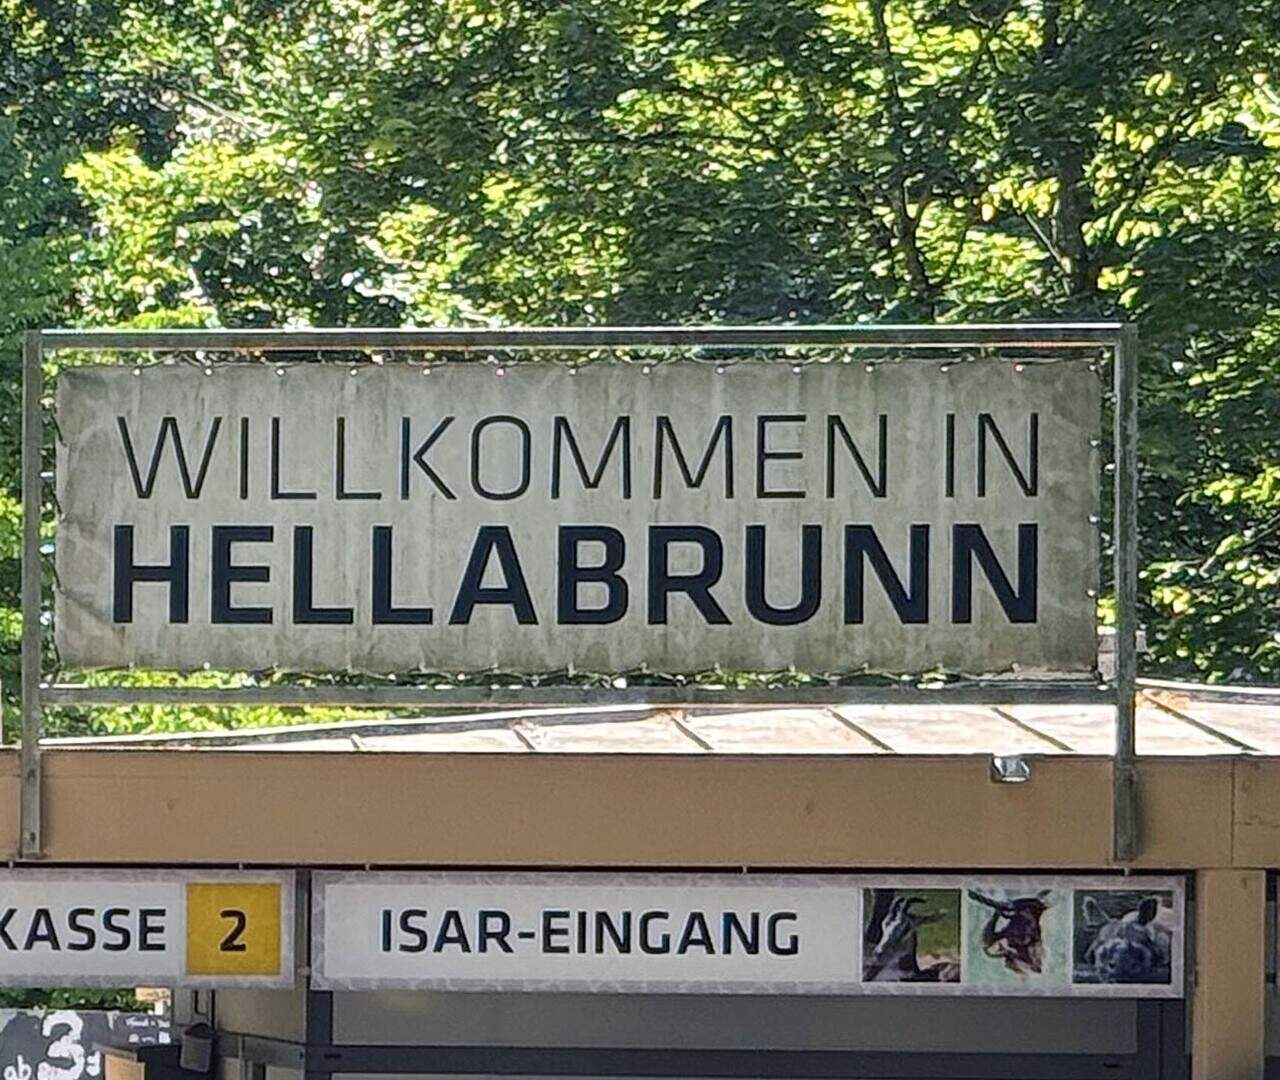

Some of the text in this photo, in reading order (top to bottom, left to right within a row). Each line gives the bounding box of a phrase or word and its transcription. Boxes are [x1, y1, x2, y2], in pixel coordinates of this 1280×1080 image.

[118, 412, 1040, 501] WILLKOMMEN IN
[114, 523, 1037, 625] HELLABRUNN
[218, 909, 248, 952] 2
[379, 909, 800, 956] ISAR-EINGANG
